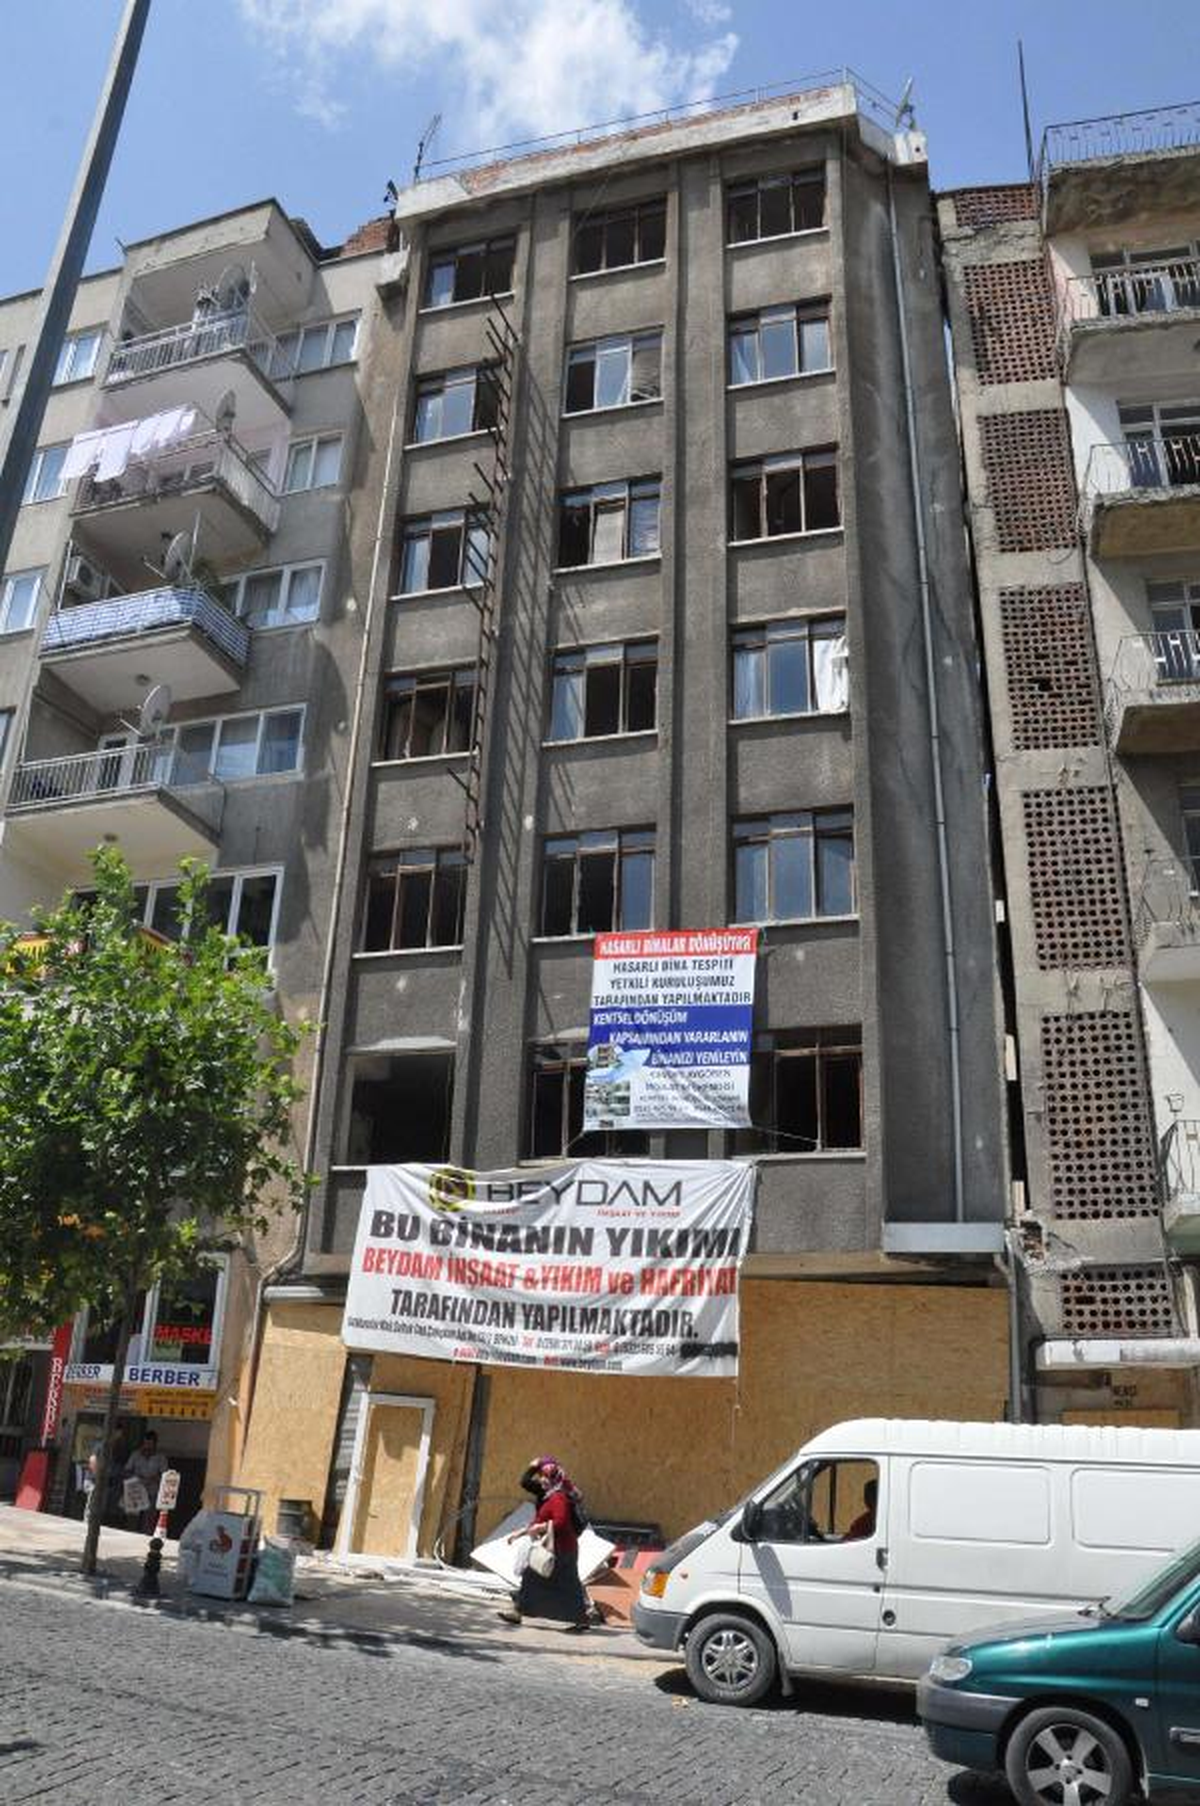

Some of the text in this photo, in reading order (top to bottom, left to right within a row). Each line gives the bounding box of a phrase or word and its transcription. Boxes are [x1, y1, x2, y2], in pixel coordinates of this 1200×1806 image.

[613, 960, 659, 973] HASARLI
[661, 958, 688, 971] BİNA
[652, 975, 736, 991] KURULUŞUMUZ
[593, 993, 659, 1007] TARAFINDAN
[593, 1010, 688, 1026] KENTSEL DÖNÜŞÜM
[683, 1030, 749, 1044] YARARLANIN
[487, 1179, 683, 1207] BEYDAM
[370, 1210, 741, 1258] BU BİNANIN YIKIMI
[362, 1246, 443, 1281] BEYDAM
[607, 1269, 635, 1295] ve
[391, 1288, 517, 1330] TARAFINDAN
[521, 1303, 699, 1339] YAPILMAKTADIR.
[128, 1367, 200, 1387] BERBER
